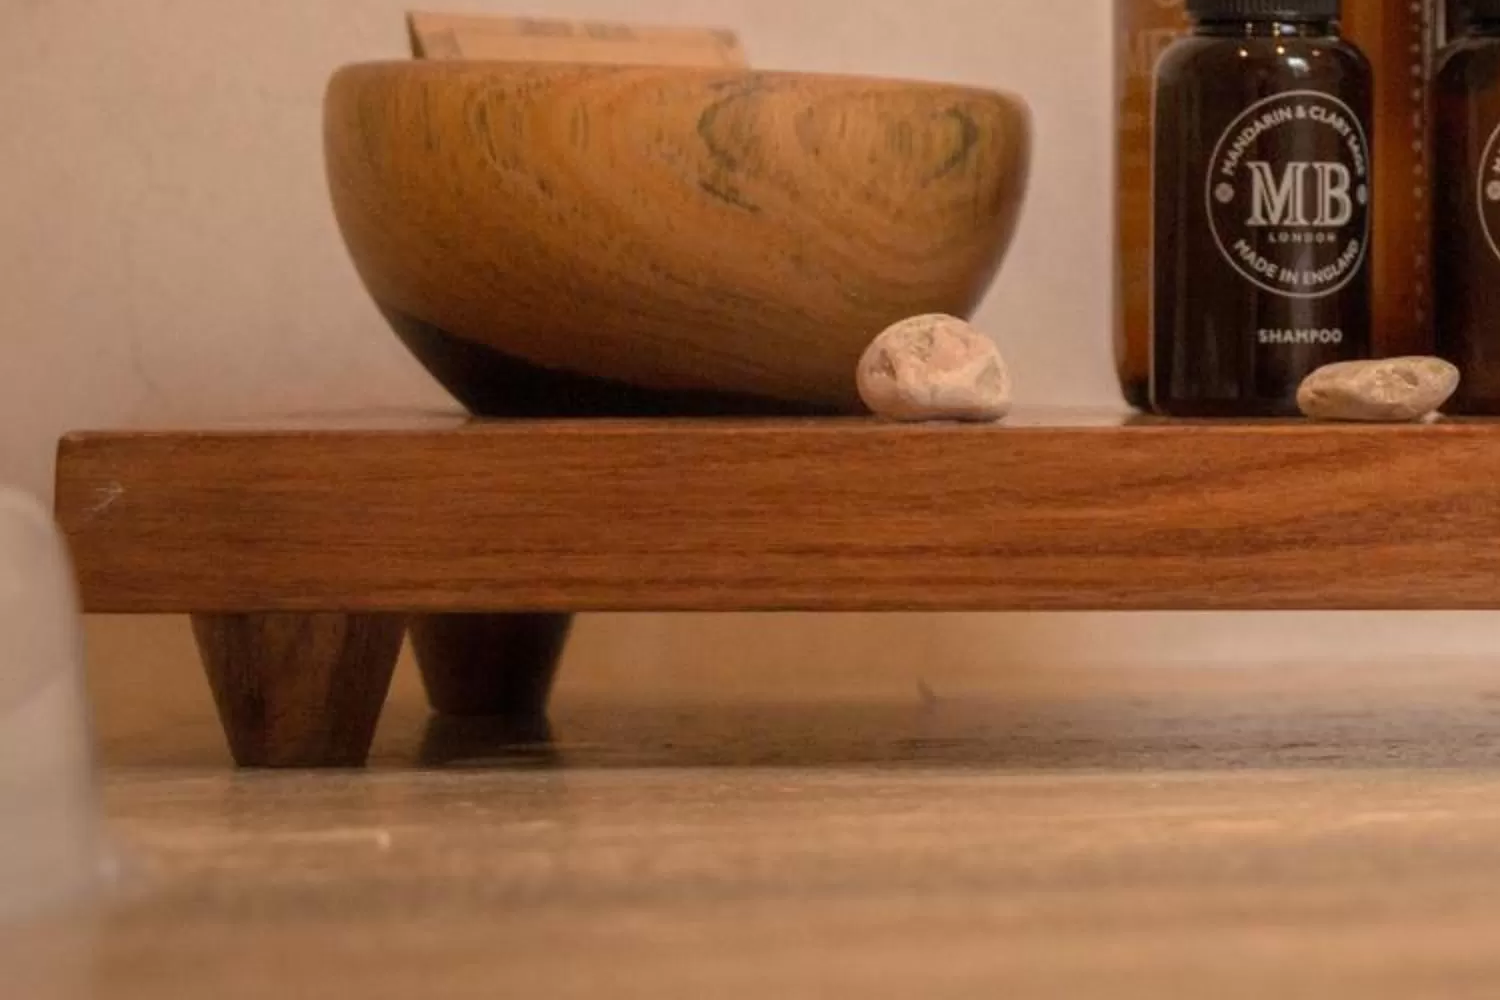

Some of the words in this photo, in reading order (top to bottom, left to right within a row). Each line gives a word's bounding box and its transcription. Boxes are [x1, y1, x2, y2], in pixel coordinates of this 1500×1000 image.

[1221, 106, 1293, 177] MANDARIN
[1309, 105, 1352, 136] CLARY
[1245, 161, 1354, 226] MB
[1268, 232, 1337, 243] LONDON
[1233, 239, 1278, 278] MADE
[1279, 268, 1297, 285] IN
[1303, 239, 1359, 285] ENGLAND
[1258, 328, 1343, 344] SHAMPOO
